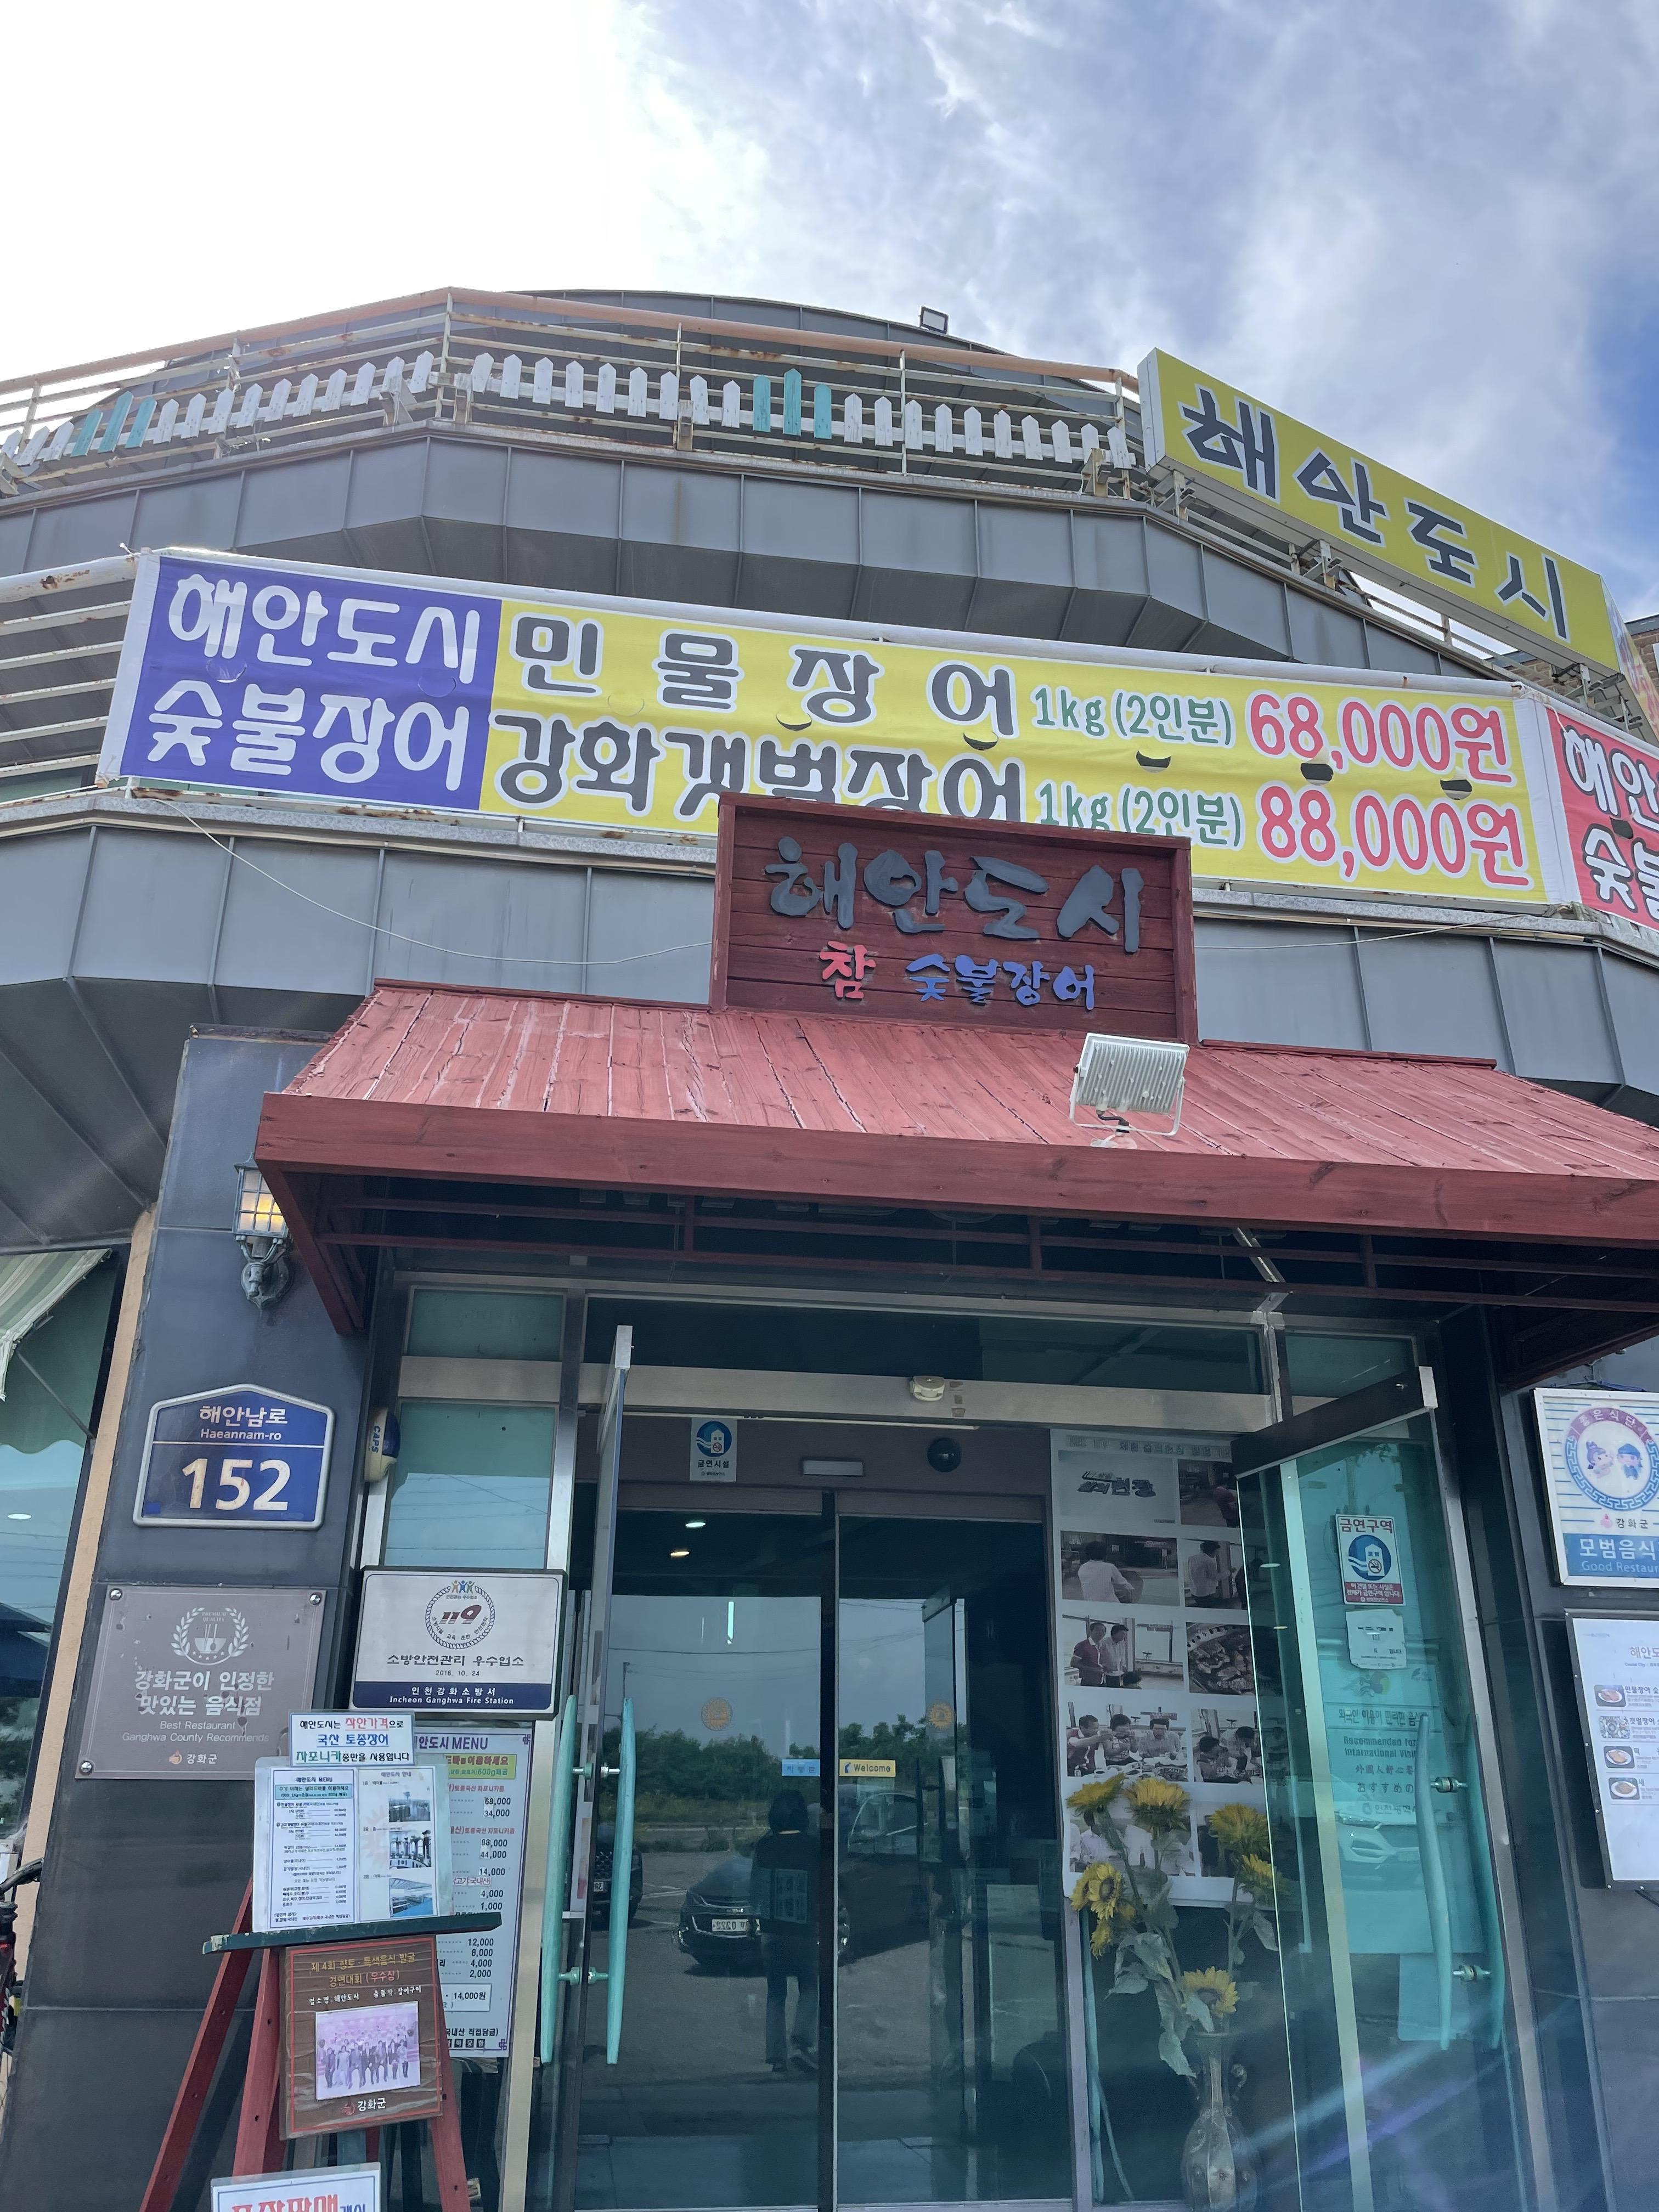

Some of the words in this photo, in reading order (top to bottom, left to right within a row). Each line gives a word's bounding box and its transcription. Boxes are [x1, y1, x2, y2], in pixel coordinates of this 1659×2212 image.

[1180, 386, 1569, 641] 해안도시
[167, 573, 481, 685] 해안도시
[146, 679, 470, 792] 숯불장어
[1034, 686, 1105, 737] 1kg
[1114, 691, 1233, 746] (2인분)
[1248, 691, 1513, 784] 68,000원
[1039, 784, 1111, 831] 1kg
[1122, 788, 1242, 848] (2인분)
[1261, 785, 1530, 888] 88,000원
[765, 836, 1144, 953] 해안도시
[819, 940, 876, 1000] 참
[905, 953, 1095, 1011] 숯불장어
[199, 1405, 288, 1428] 해안남로
[200, 1428, 282, 1441] Haeannam-ro
[371, 1425, 381, 1453] CAPS
[697, 1459, 729, 1468] 금연시설
[182, 1458, 291, 1511] 152
[1340, 1518, 1393, 1534] 금연구역
[1579, 1538, 1659, 1561] 모범음식
[1581, 1560, 1613, 1572] Good
[439, 1604, 482, 1624] 119
[387, 1655, 465, 1666] 소방안전관리
[472, 1656, 524, 1667] 우수업소
[134, 1671, 211, 1691] 강화군이
[219, 1671, 274, 1691] 인정한
[139, 1695, 197, 1716] 맛있는
[205, 1696, 262, 1716] 음식점
[389, 1696, 422, 1704] Incheon
[426, 1696, 463, 1705] Ganghwa
[485, 1696, 514, 1705] Station
[160, 1720, 182, 1730] Best
[185, 1720, 236, 1730] Restaurant
[122, 1732, 167, 1743] Ganghwa
[170, 1733, 204, 1743] County
[206, 1733, 270, 1742] Recommends
[317, 1734, 340, 1746] 국산
[346, 1734, 389, 1746] 토종장어
[414, 1735, 449, 1750] 안도시
[452, 1737, 489, 1750] MENU
[1345, 1747, 1397, 1758] International
[187, 1753, 218, 1765] 강화군
[853, 1763, 891, 1773] Welcome
[484, 1797, 511, 1806] 68,000
[484, 1809, 510, 1819] 34,000
[481, 1838, 508, 1848] 88,000
[480, 1850, 507, 1859] 44,000
[479, 1867, 506, 1877] 14,000
[453, 1876, 491, 1886] 고기:국내산)
[481, 1889, 504, 1899] 4,000
[481, 1902, 503, 1911] 1,000
[467, 1938, 494, 1948] 12,000
[471, 1949, 493, 1958] 8,000
[470, 1959, 492, 1968] 4,000
[329, 1973, 362, 1988] 경연대회
[470, 1970, 492, 1979] 2,000
[453, 1991, 486, 2001] 14,000원
[357, 2097, 386, 2112] 강화군
